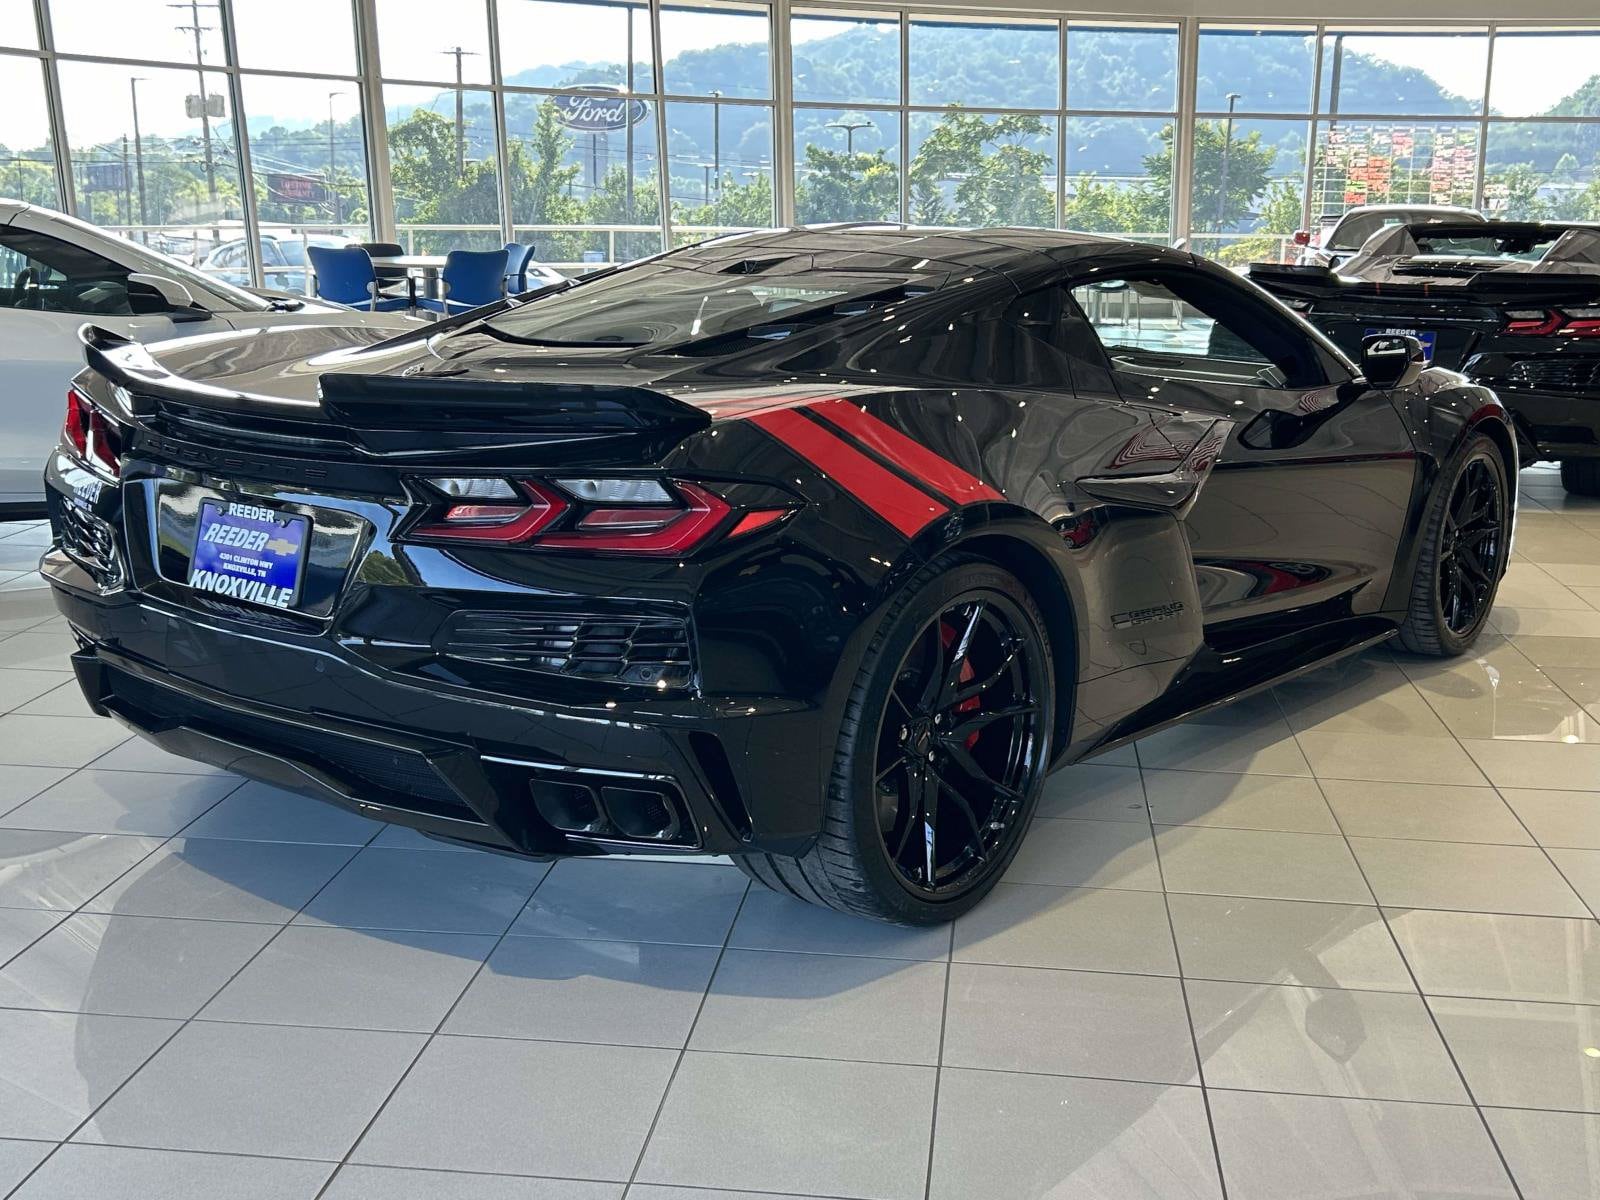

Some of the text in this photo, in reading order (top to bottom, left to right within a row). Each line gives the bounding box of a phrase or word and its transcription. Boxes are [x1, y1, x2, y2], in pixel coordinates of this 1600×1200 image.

[565, 96, 625, 122] Ford
[1385, 328, 1416, 336] REEDER
[228, 502, 275, 523] REEDER
[203, 523, 270, 552] REEDER
[233, 555, 259, 567] CLINTON
[259, 560, 274, 570] HWY
[257, 569, 267, 578] TN
[189, 568, 293, 608] KNOXVILLE
